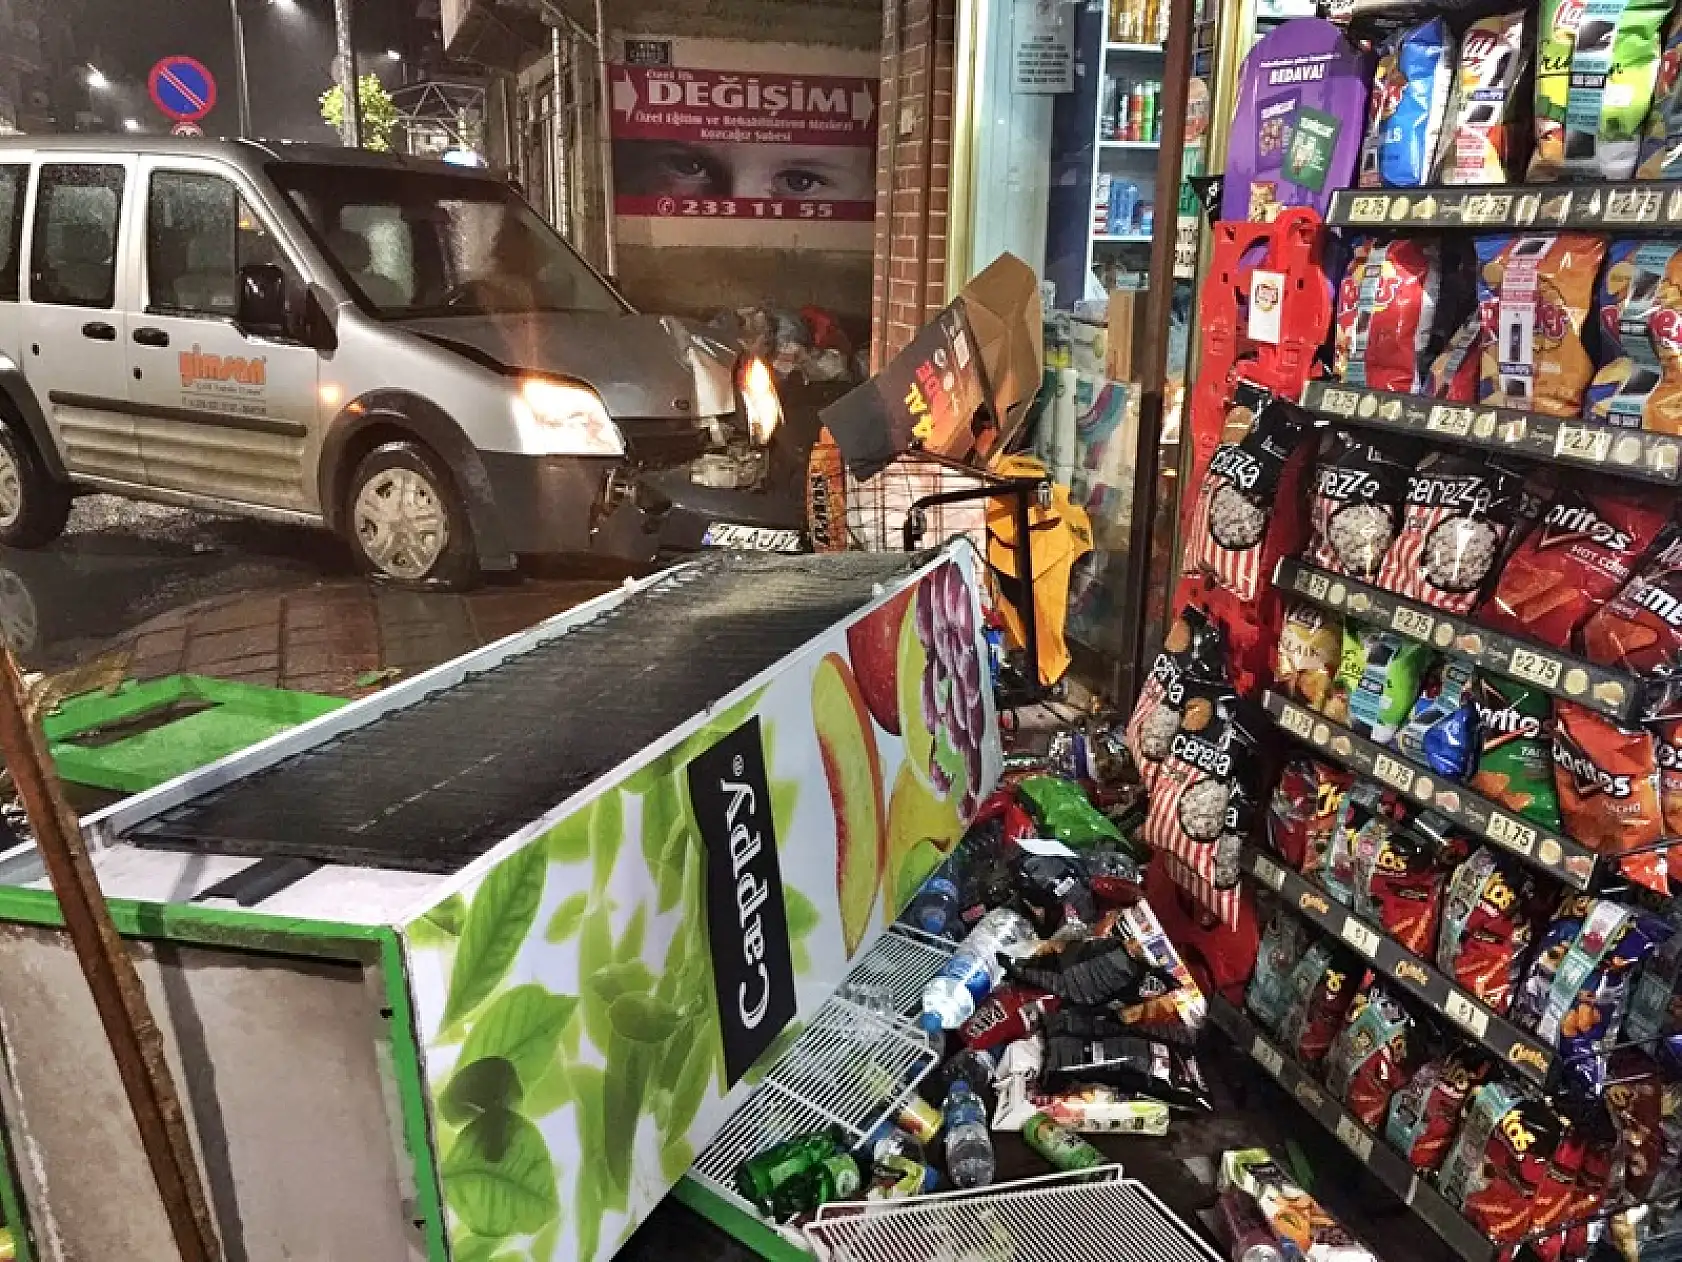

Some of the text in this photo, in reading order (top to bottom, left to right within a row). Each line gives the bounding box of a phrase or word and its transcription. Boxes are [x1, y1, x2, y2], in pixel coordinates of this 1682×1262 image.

[648, 75, 848, 117] DEĞİŞİM
[682, 199, 833, 218] 233 11 55
[720, 777, 771, 1030] Cappy
